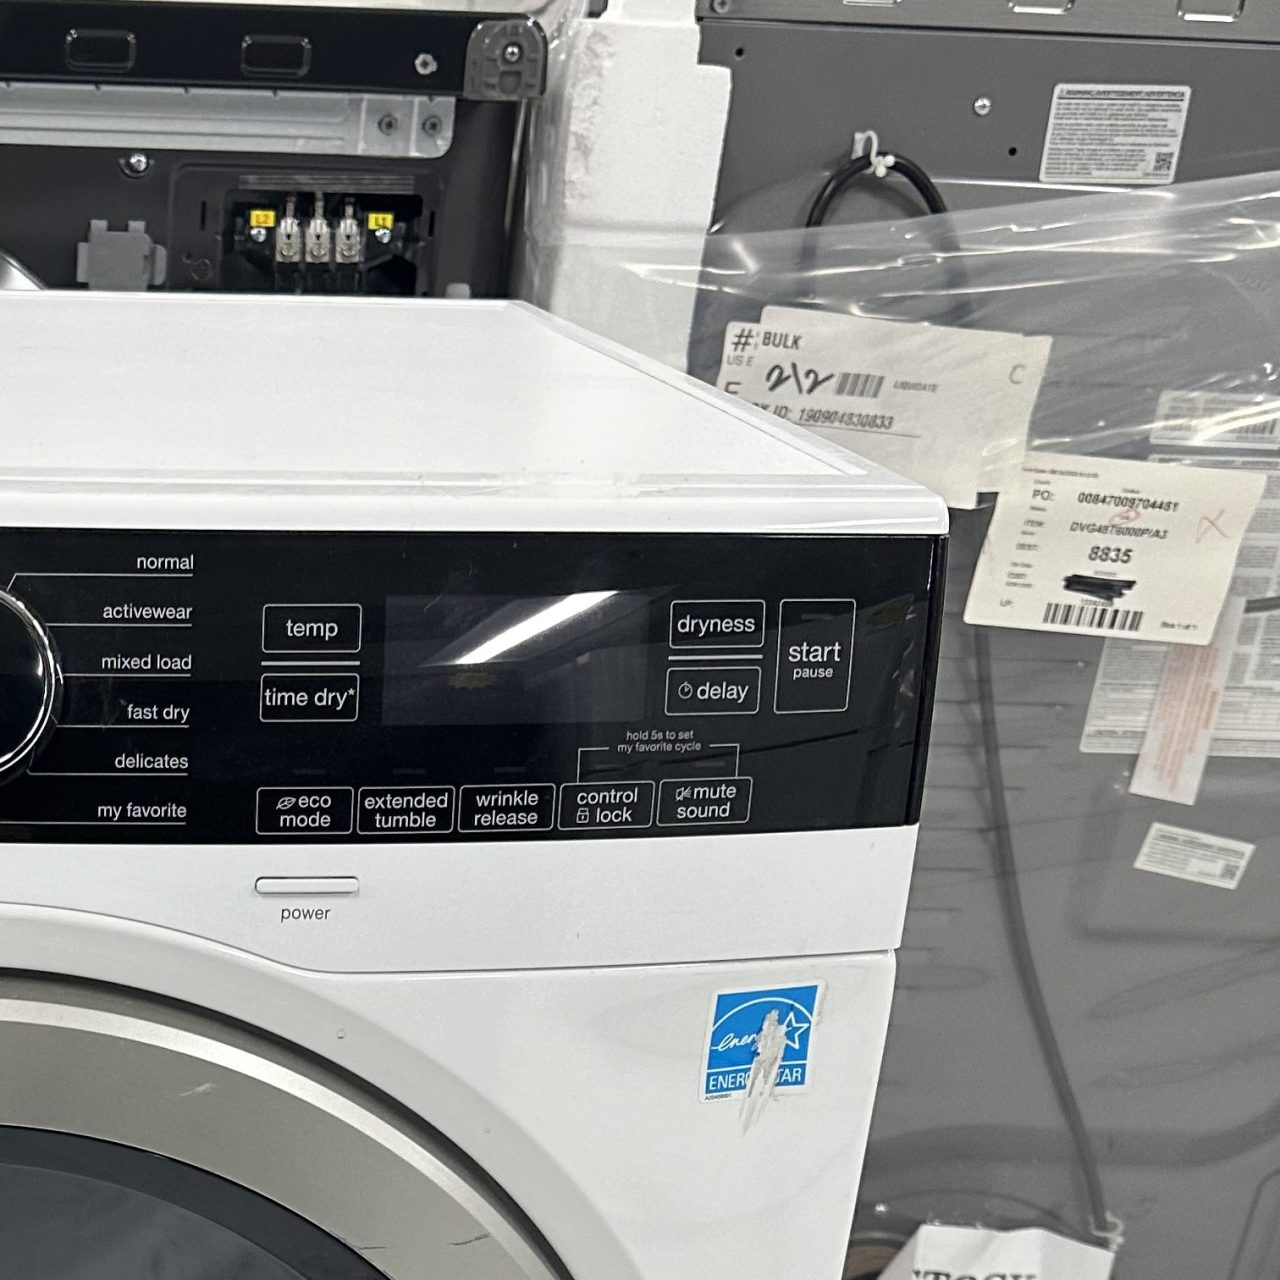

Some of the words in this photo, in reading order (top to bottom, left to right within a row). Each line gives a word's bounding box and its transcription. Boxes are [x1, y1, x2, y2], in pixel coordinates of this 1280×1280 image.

[762, 331, 802, 350] BULK
[136, 554, 194, 570] normal
[1088, 545, 1132, 564] 8835
[102, 603, 193, 621] activewear
[286, 619, 338, 640] temp
[677, 614, 756, 637] dryness
[788, 641, 842, 662] start
[101, 653, 152, 670] mixed
[155, 653, 192, 670] load
[793, 665, 834, 680] pause
[264, 688, 308, 706] time
[697, 681, 749, 703] delay
[126, 703, 158, 720] fast
[162, 704, 191, 723] dry
[626, 730, 649, 740] hold
[651, 730, 663, 740] 5s
[666, 730, 676, 740] to
[678, 730, 694, 740] set
[617, 743, 633, 755] my
[636, 741, 673, 753] favorite
[675, 741, 702, 754] cycle
[114, 754, 189, 770] delicates
[476, 789, 539, 807] wrinkle
[577, 787, 638, 805] control
[693, 784, 737, 799] mute
[298, 796, 332, 809] eco
[364, 792, 449, 810] extended
[97, 805, 122, 821] my
[126, 801, 187, 818] favorite
[474, 809, 538, 826] release
[596, 807, 632, 823] lock
[677, 802, 730, 819] sound
[280, 812, 331, 828] mode
[375, 812, 437, 828] tumble
[280, 906, 331, 923] power
[709, 1071, 749, 1091] ENER
